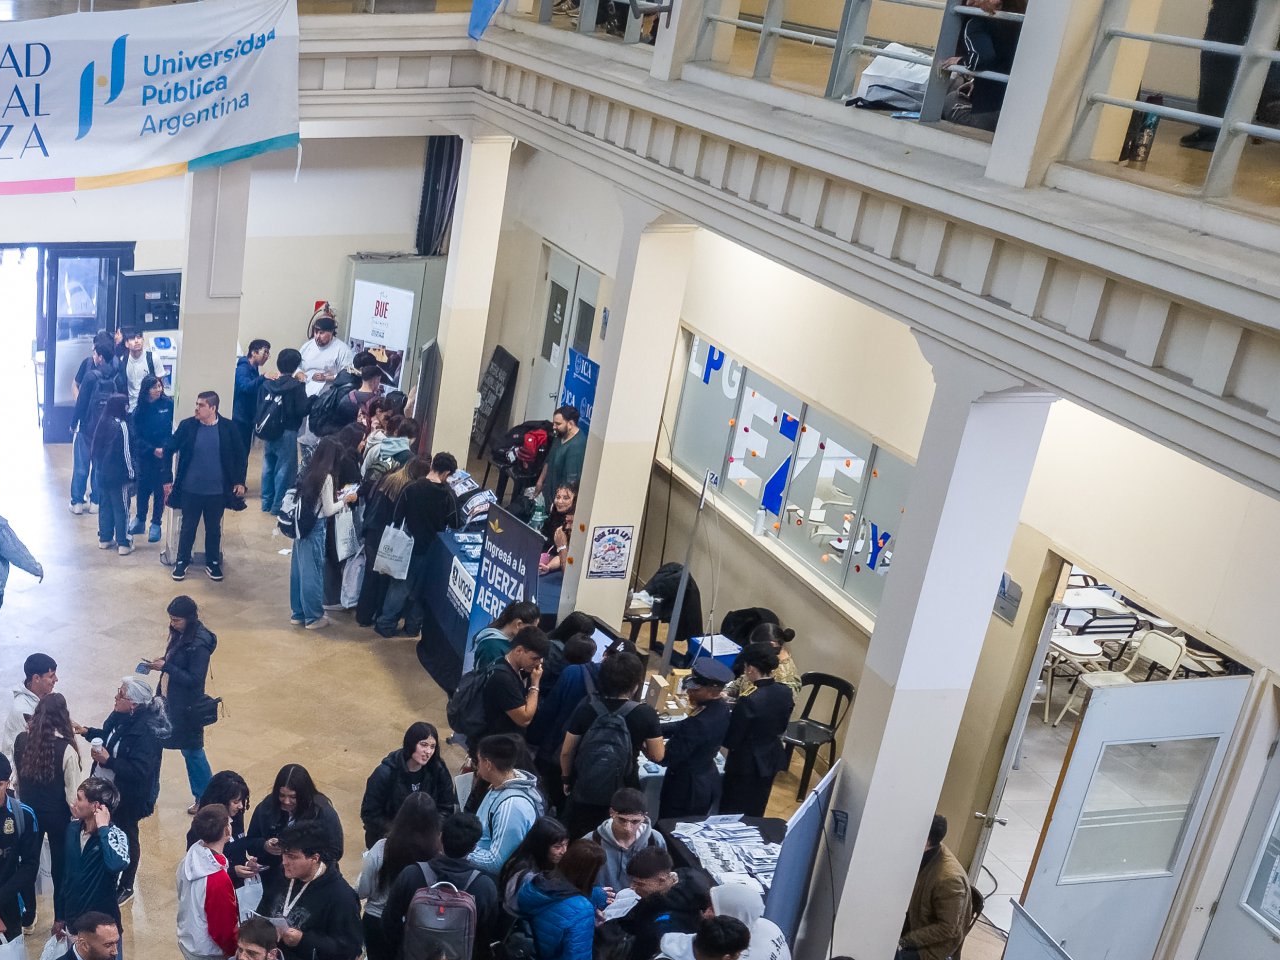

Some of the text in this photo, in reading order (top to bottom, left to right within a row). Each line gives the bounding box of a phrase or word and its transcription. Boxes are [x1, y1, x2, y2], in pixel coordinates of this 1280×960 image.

[142, 26, 277, 78] Universidad
[141, 71, 229, 108] Pública
[140, 89, 251, 137] Argentina
[374, 300, 389, 319] BUE
[607, 528, 620, 536] SEA
[484, 535, 526, 576] Ingresá a la
[481, 557, 524, 603] FUERZA
[476, 585, 507, 620] AÉRE
